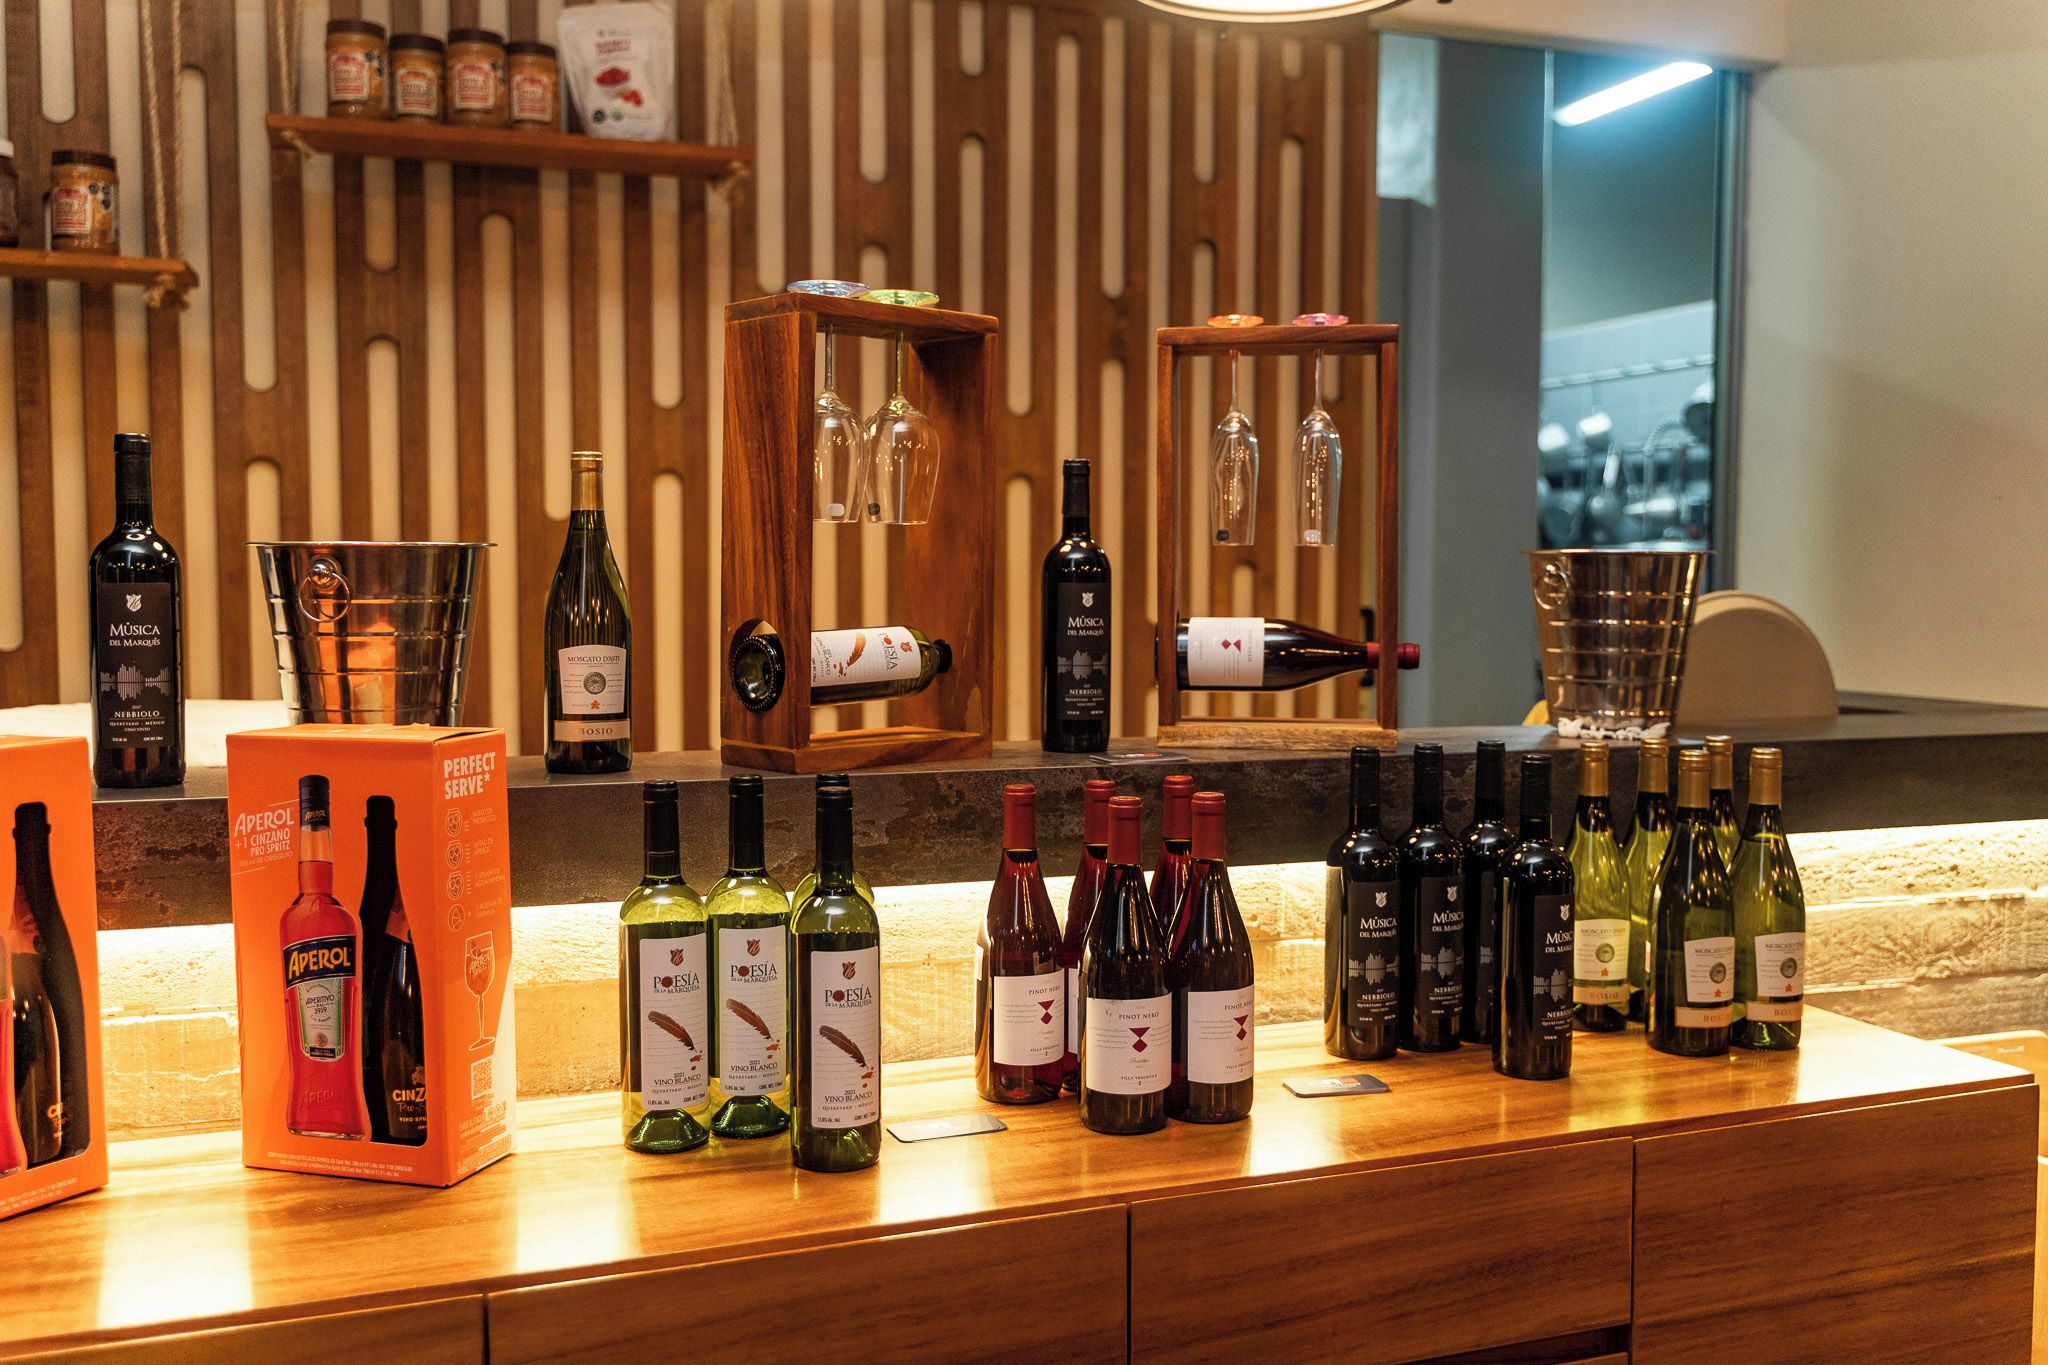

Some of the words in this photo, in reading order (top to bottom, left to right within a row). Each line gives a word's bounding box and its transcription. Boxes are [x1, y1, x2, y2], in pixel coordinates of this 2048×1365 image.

[1068, 615, 1105, 628] MÚSICA
[110, 621, 161, 637] MÚSICA
[109, 639, 122, 647] DEL
[114, 710, 160, 718] NEBBIOLO
[580, 727, 613, 735] BOSIO
[443, 751, 496, 779] PERFECT
[234, 807, 295, 837] APEROL
[250, 828, 291, 847] CINZANO
[250, 845, 265, 858] PRO
[266, 840, 291, 854] SPRITZ
[1360, 916, 1397, 929] MÚSICA
[288, 946, 351, 980] APEROL
[730, 960, 778, 978] POESÍA
[653, 969, 700, 989] POESÍA
[744, 975, 778, 983] MARQUESA
[667, 985, 700, 994] MARQUESA
[825, 984, 872, 1003] POESÍA
[839, 999, 872, 1008] MARQUESA
[1142, 1011, 1160, 1019] NERO
[750, 1062, 778, 1071] BLANCO
[675, 1073, 701, 1084] BLANCO
[392, 1087, 426, 1102] CINZ
[845, 1091, 873, 1101] BLANCO
